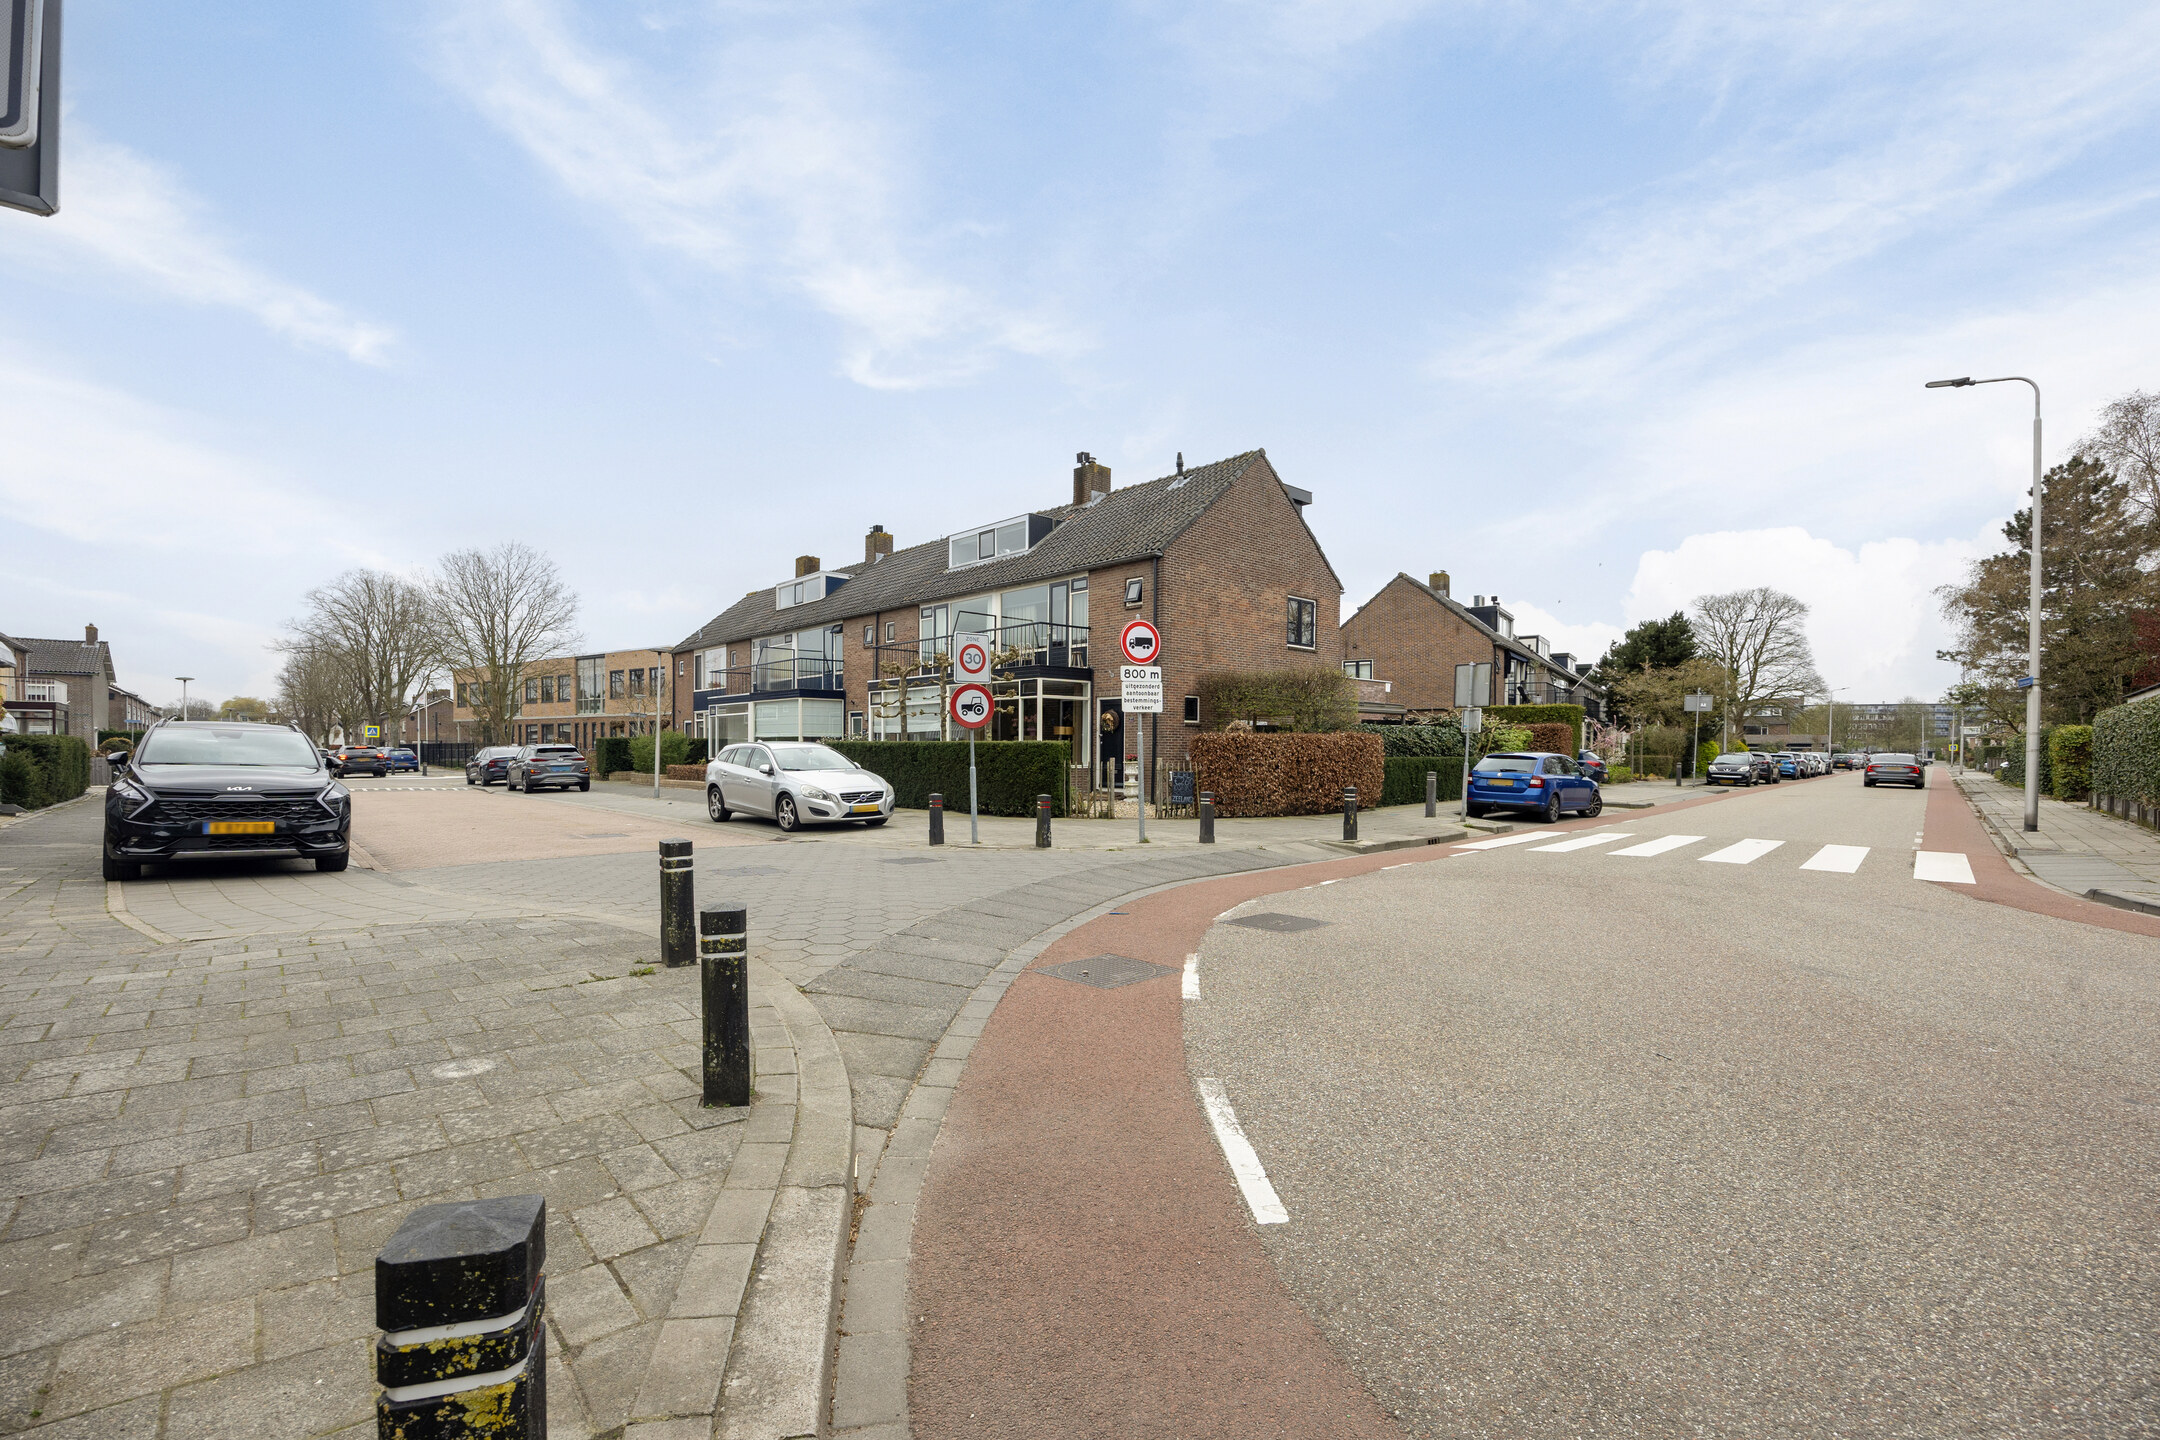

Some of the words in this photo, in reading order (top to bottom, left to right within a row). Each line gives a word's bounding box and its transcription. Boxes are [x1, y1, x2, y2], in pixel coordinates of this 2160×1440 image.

[965, 653, 982, 665] 30
[1124, 669, 1146, 679] 800
[1150, 671, 1160, 679] m
